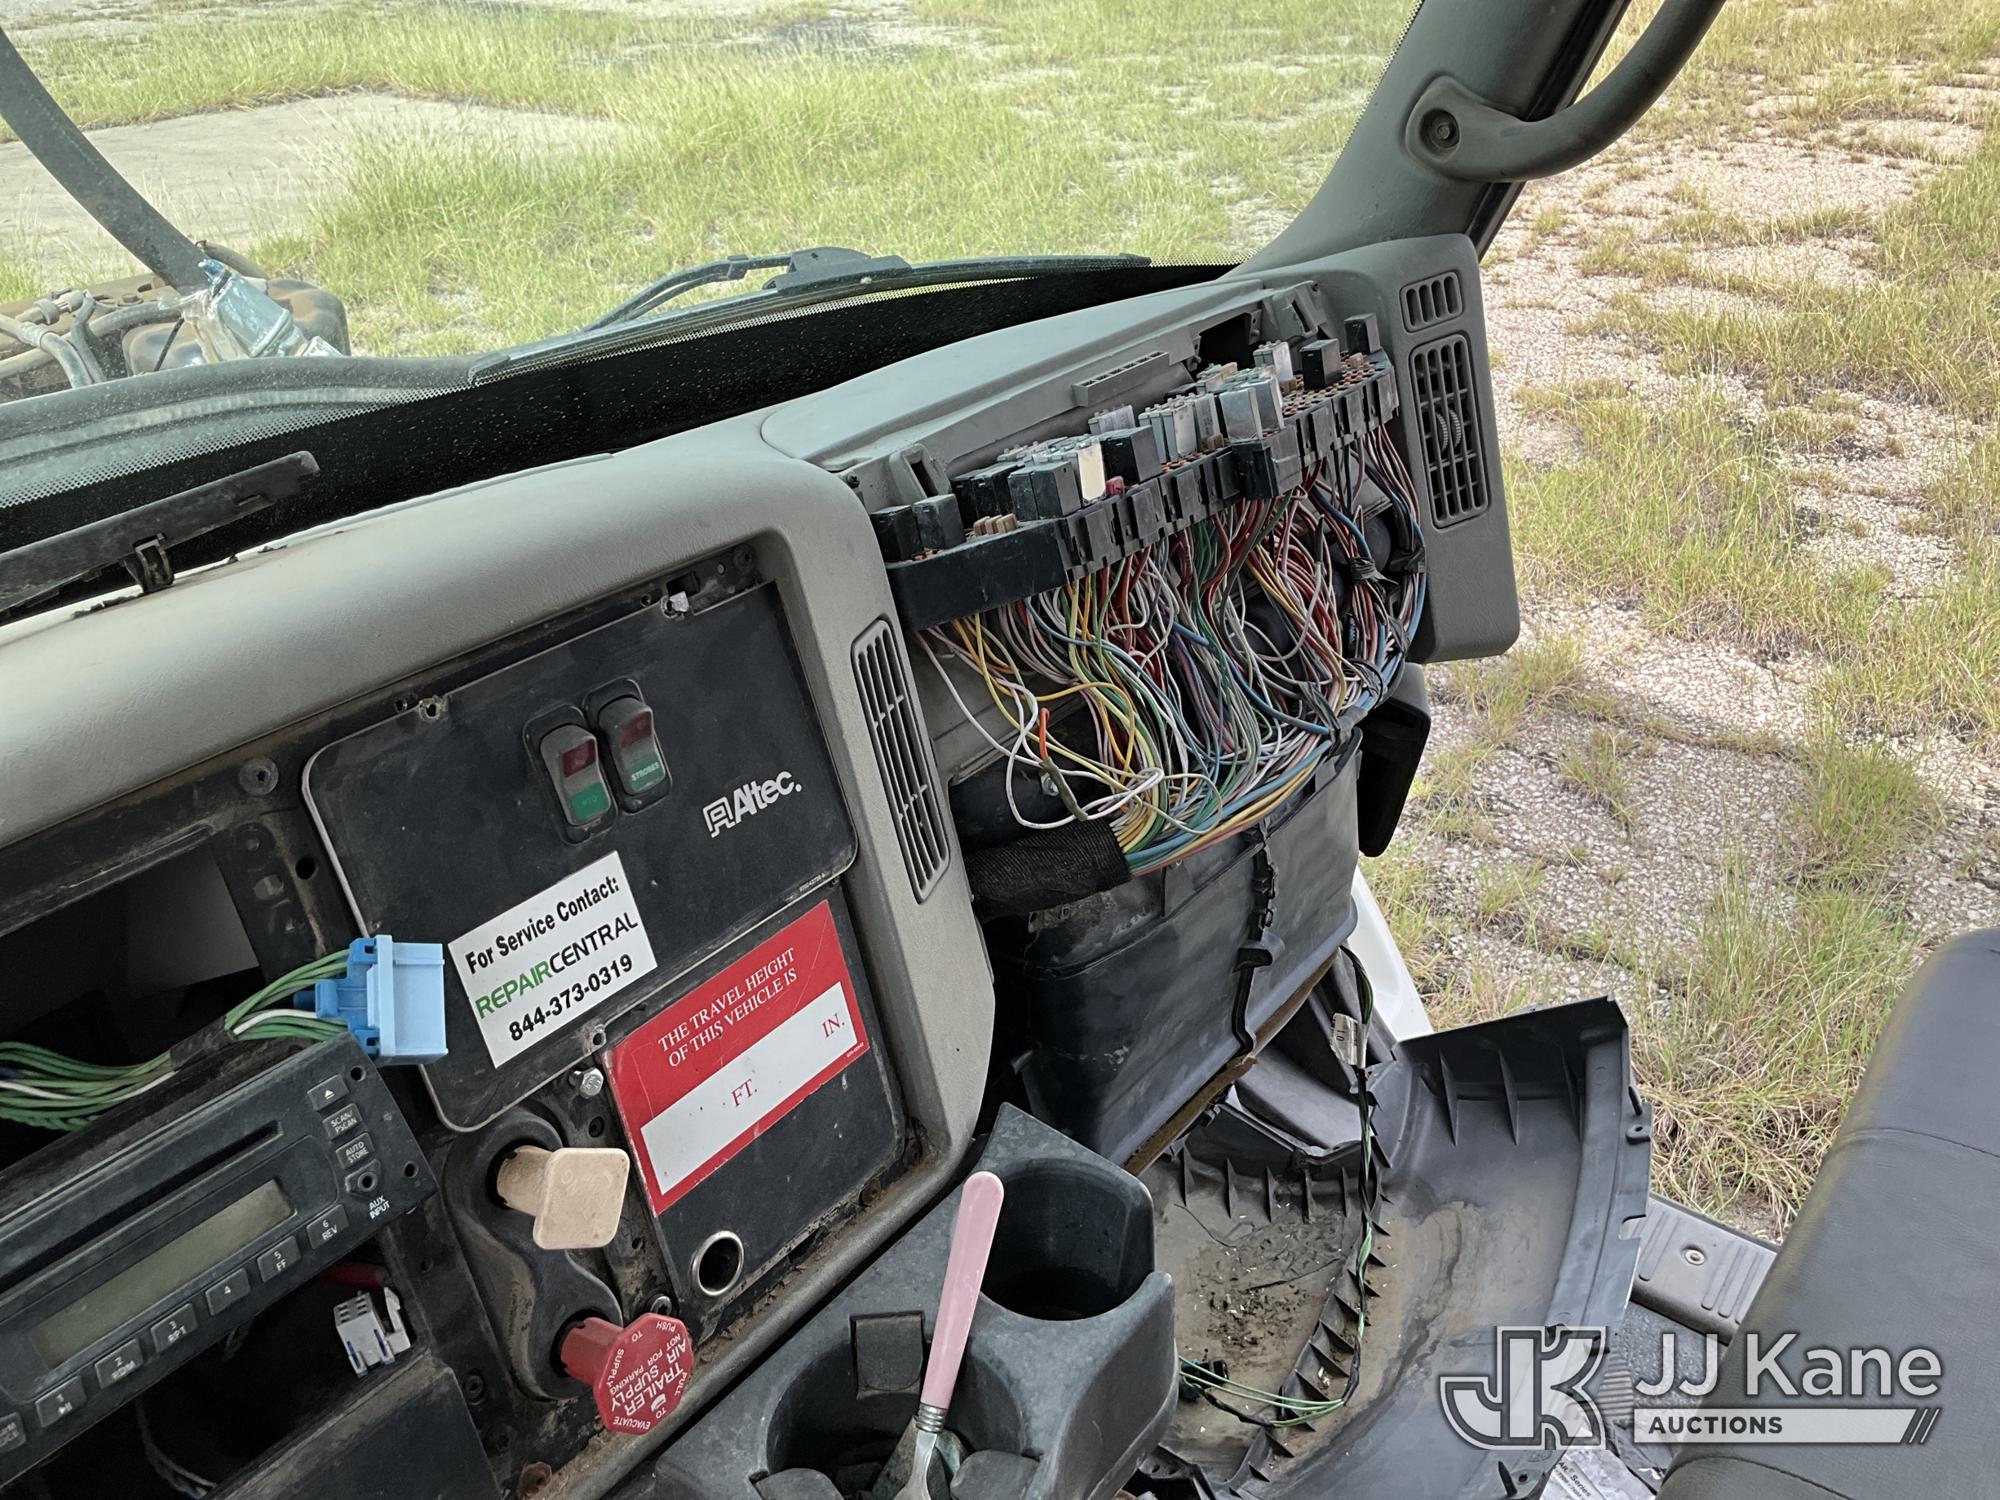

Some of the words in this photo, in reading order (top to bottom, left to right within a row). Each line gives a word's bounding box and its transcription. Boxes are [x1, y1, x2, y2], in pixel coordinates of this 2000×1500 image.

[465, 948, 494, 975] For
[495, 914, 556, 957] Service
[556, 876, 620, 922] Contact:
[508, 953, 632, 1041] 844-373-0319
[658, 1022, 690, 1053] THE
[689, 986, 746, 1031] TRAVEL
[744, 948, 796, 993] HEIGHT
[668, 1045, 690, 1067] OF
[688, 1025, 722, 1058] THIS
[723, 982, 783, 1036] VEHICLE
[782, 968, 798, 990] IS
[822, 1013, 846, 1038] IN.
[730, 1078, 758, 1108] FT.
[345, 1141, 365, 1156] AUTO
[348, 1147, 369, 1163] STORE
[370, 1196, 386, 1210] AUX
[370, 1200, 391, 1220] INPUT
[322, 1219, 329, 1228] 6
[322, 1226, 338, 1240] REV
[274, 1251, 282, 1260] 5
[276, 1259, 287, 1272] FF
[168, 1320, 177, 1330] 3
[656, 1320, 676, 1333] PUSH
[167, 1326, 188, 1344] RPT
[631, 1330, 644, 1342] TO
[666, 1334, 681, 1350] NOT
[647, 1349, 664, 1365] FOR
[666, 1338, 687, 1364] AIR
[111, 1360, 136, 1380] RDM
[114, 1356, 124, 1367] 2
[606, 1348, 625, 1389] SUPPLY
[610, 1366, 644, 1395] PARKING
[611, 1364, 660, 1412] SUPPLY
[624, 1362, 684, 1416] TRAILER
[674, 1372, 688, 1396] PULL
[656, 1408, 668, 1419] TO
[613, 1416, 651, 1430] EVACUATE
[1570, 1474, 1592, 1497] Series
